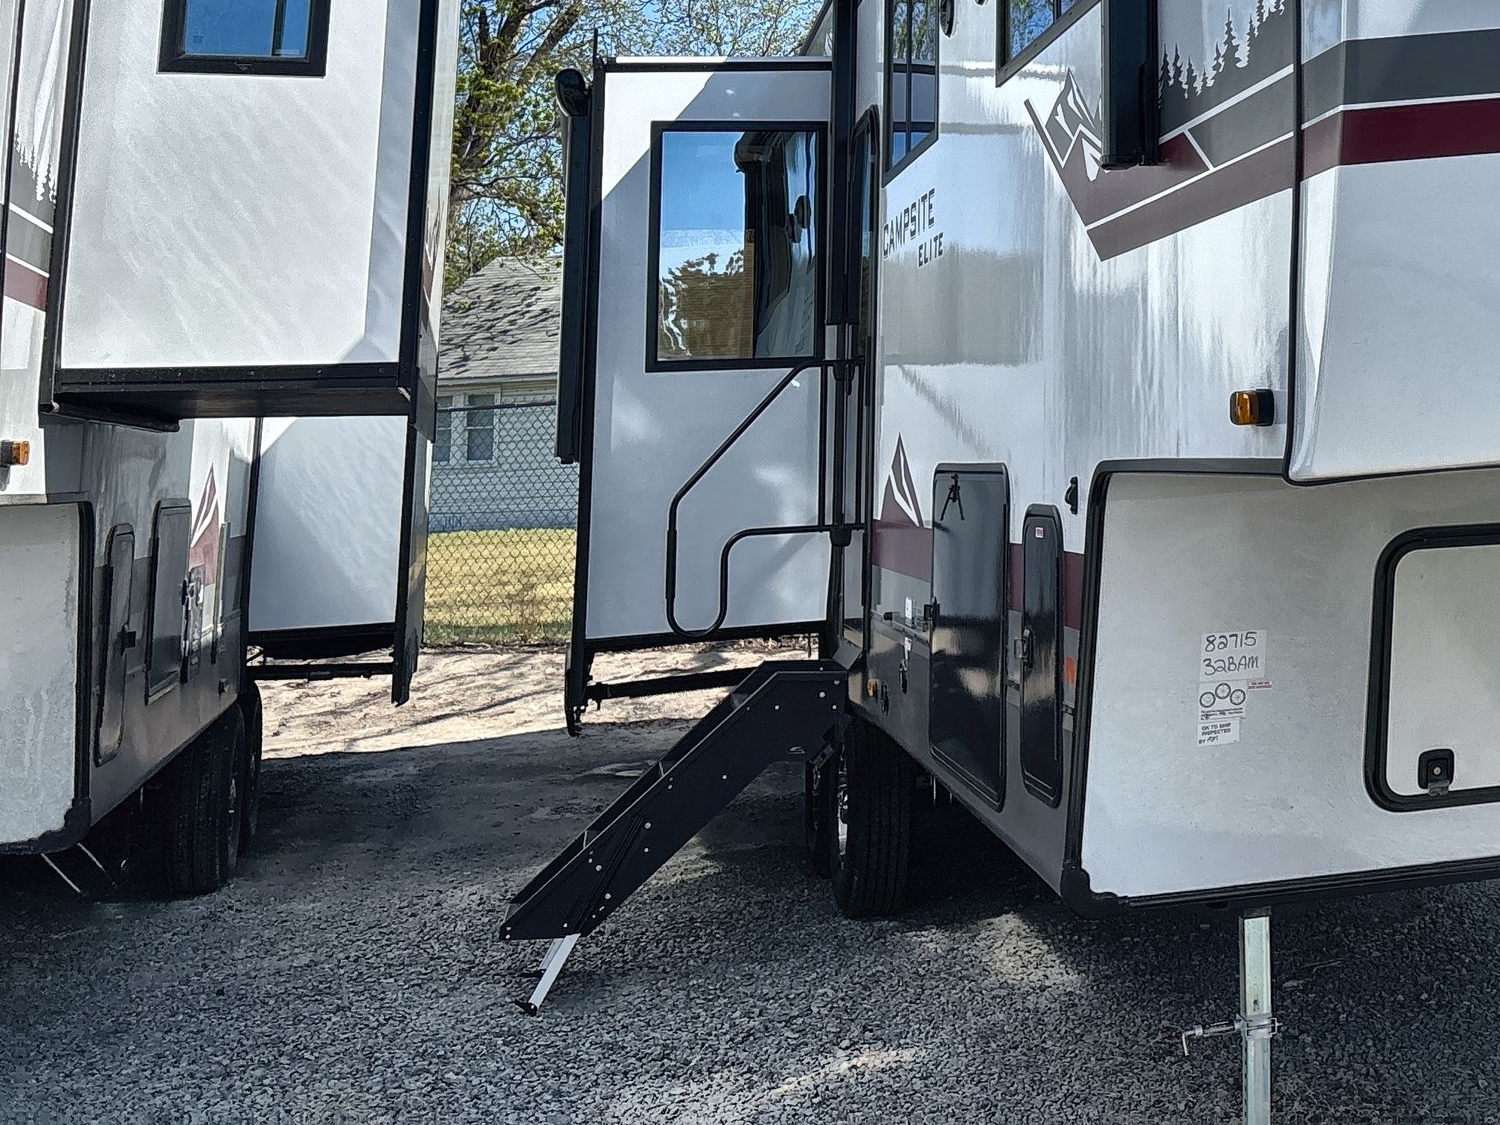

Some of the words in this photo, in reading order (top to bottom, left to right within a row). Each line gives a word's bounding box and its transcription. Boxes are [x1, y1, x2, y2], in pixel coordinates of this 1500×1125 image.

[883, 188, 936, 257] CAMPSITE
[918, 232, 944, 267] ELITE
[1205, 631, 1258, 652] 82715
[1203, 655, 1259, 676] 32BAM
